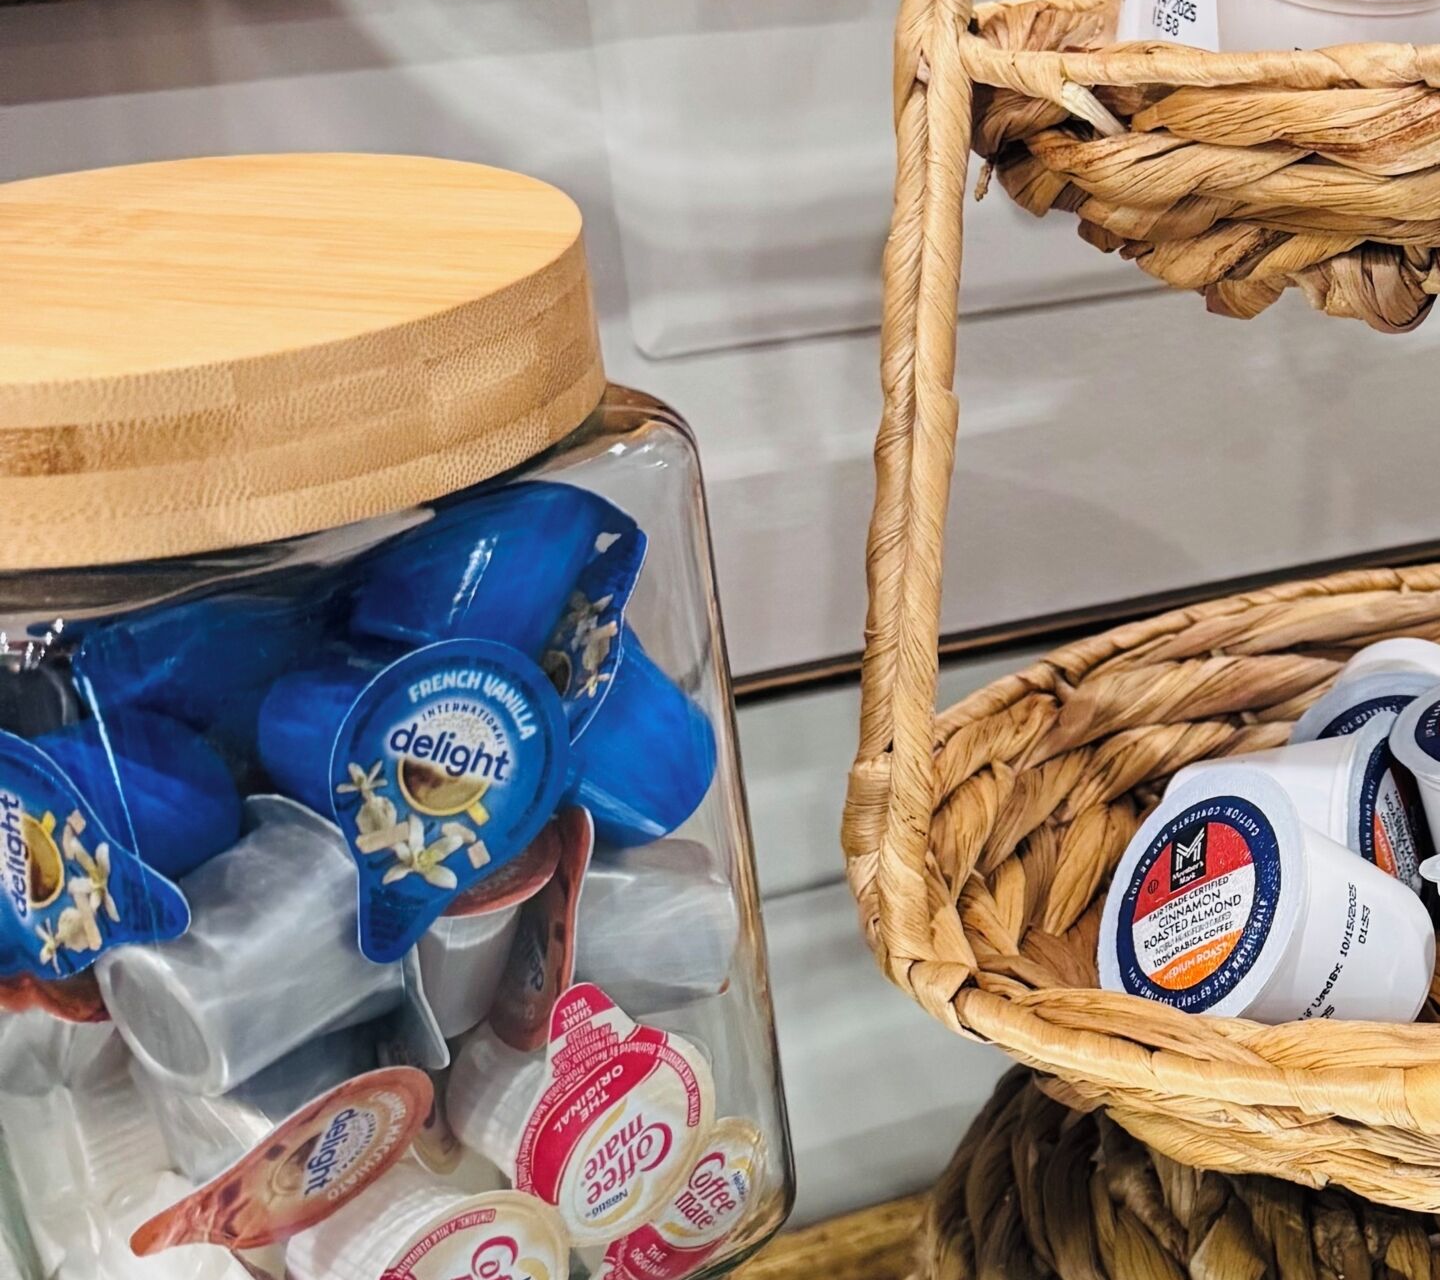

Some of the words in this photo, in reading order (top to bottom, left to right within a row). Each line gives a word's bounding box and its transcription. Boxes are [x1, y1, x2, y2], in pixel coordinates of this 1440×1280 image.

[408, 669, 483, 704] FRENCH
[481, 673, 538, 740] VANILLA
[421, 701, 506, 745] INTERNATIONAL
[389, 723, 510, 782] delight
[1143, 918, 1189, 951] ROASTED
[1190, 893, 1242, 925] ALMOND
[1158, 889, 1222, 929] CINNAMON
[1339, 880, 1357, 958] 10/15/2025
[1171, 936, 1203, 958] ARABICA
[560, 996, 588, 1019] WELL
[561, 1005, 593, 1032] SHAKE
[553, 1064, 624, 1134] ORIGINAL
[580, 1089, 610, 1123] THE
[304, 1107, 359, 1196] delight
[585, 1112, 644, 1180] mate
[586, 1122, 673, 1205] Coffee
[674, 1190, 714, 1230] mate
[688, 1151, 737, 1216] Coffee
[645, 1242, 668, 1263] THE
